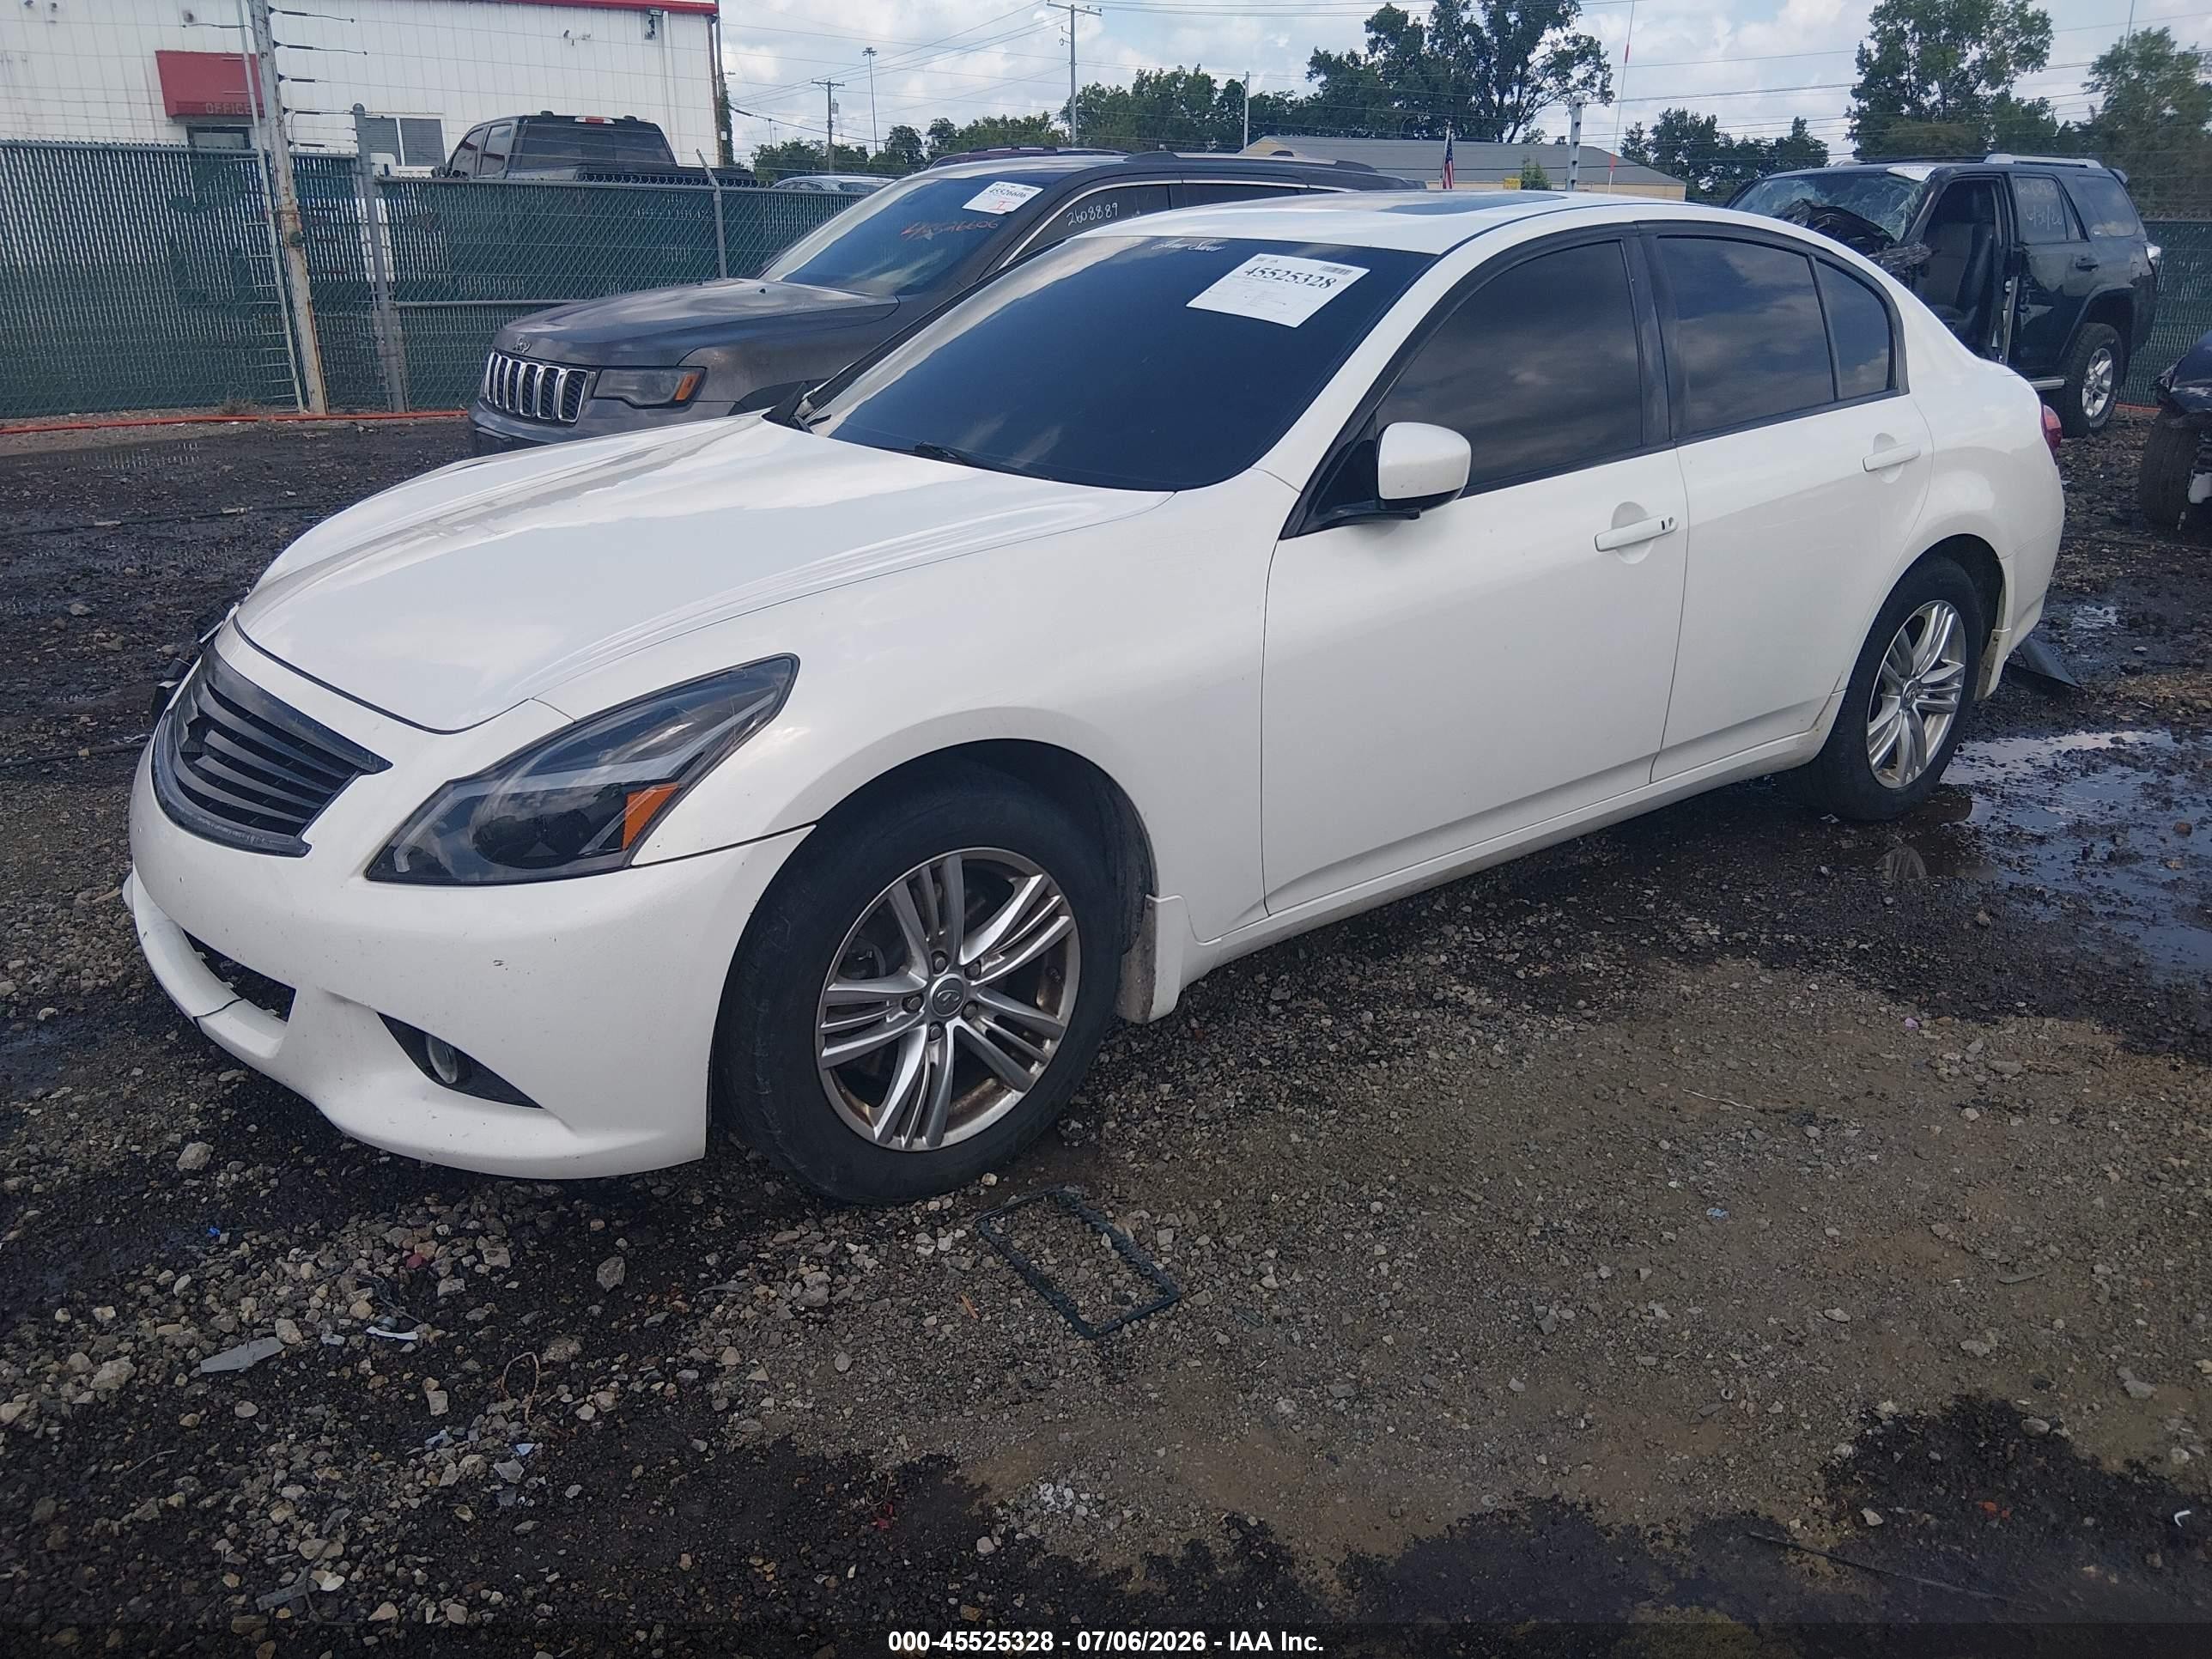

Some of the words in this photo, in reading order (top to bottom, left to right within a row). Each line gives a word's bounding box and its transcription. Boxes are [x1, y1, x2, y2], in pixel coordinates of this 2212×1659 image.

[206, 102, 252, 114] OFFICE
[1066, 202, 1118, 227] 2608889
[1243, 265, 1338, 289] 45525328
